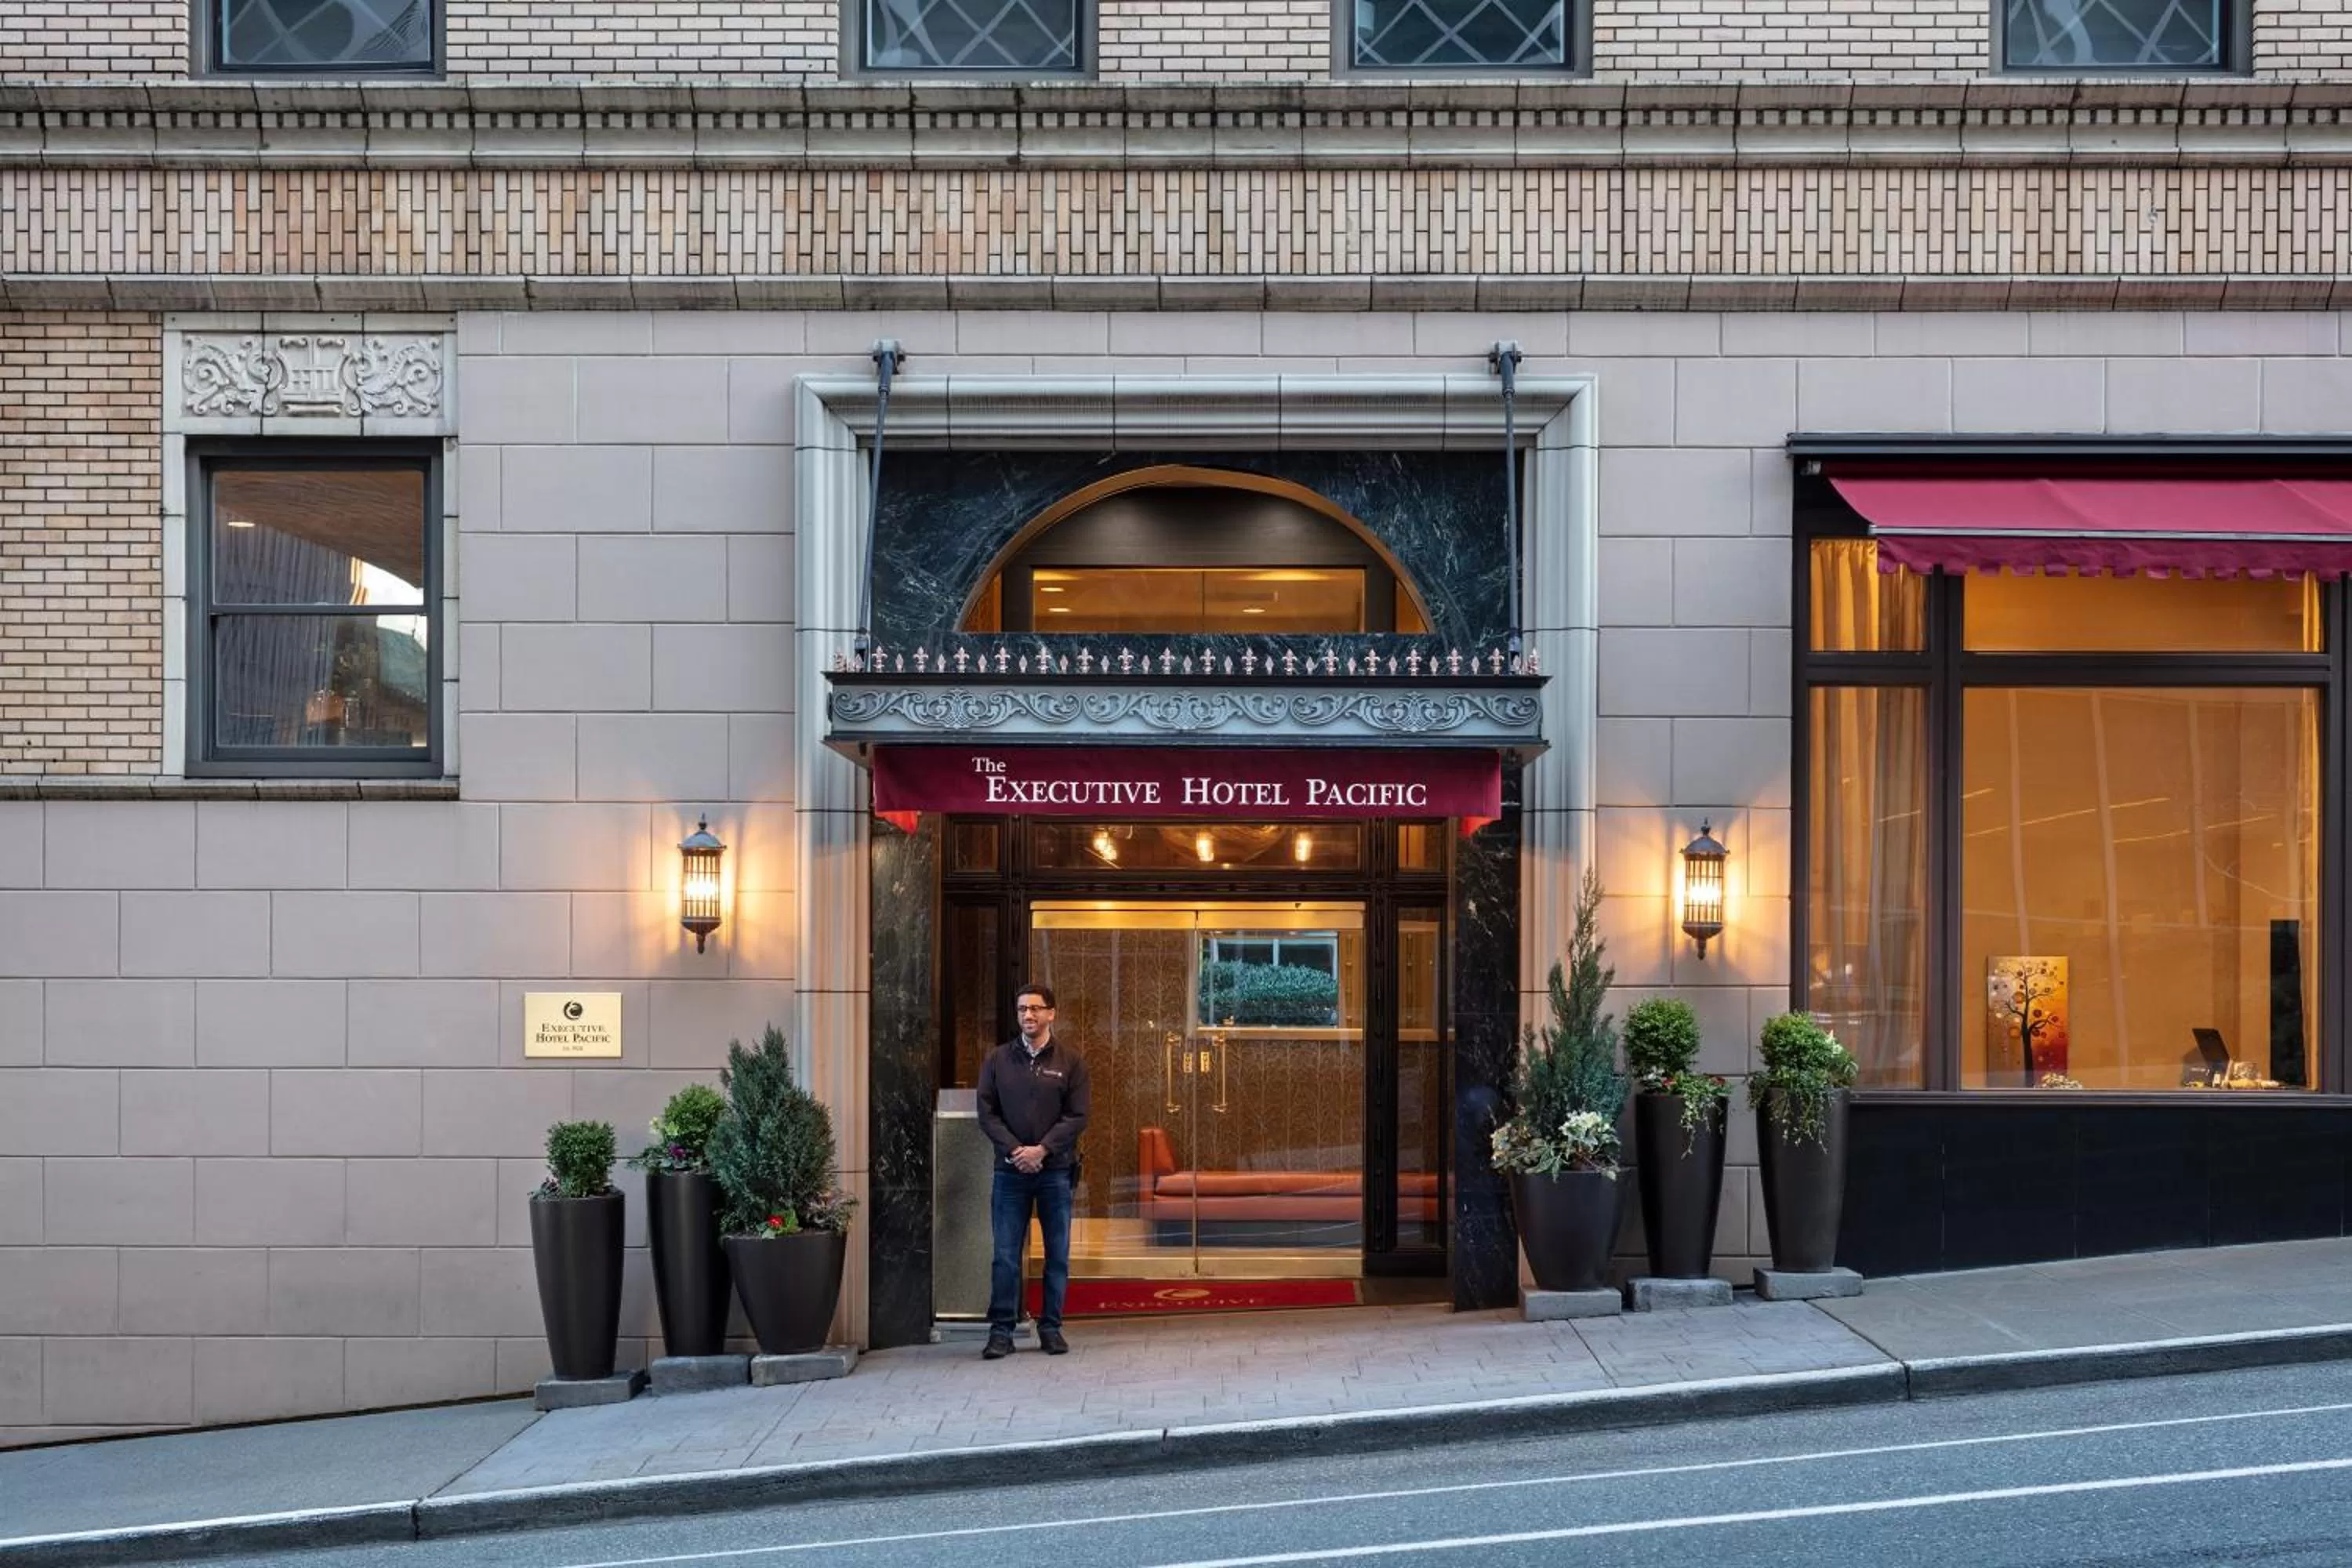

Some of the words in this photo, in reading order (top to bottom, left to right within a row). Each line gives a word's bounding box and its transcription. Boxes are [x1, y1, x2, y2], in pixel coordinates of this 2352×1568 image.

[972, 757, 1007, 773] The
[985, 775, 1161, 804] EXECUTIVE
[1181, 777, 1290, 806] HOTEL
[1305, 779, 1427, 806] PACIFIC
[541, 1023, 605, 1033] EXECUTIVE
[535, 1033, 569, 1044] HOTEL
[573, 1033, 611, 1044] PACIFIC
